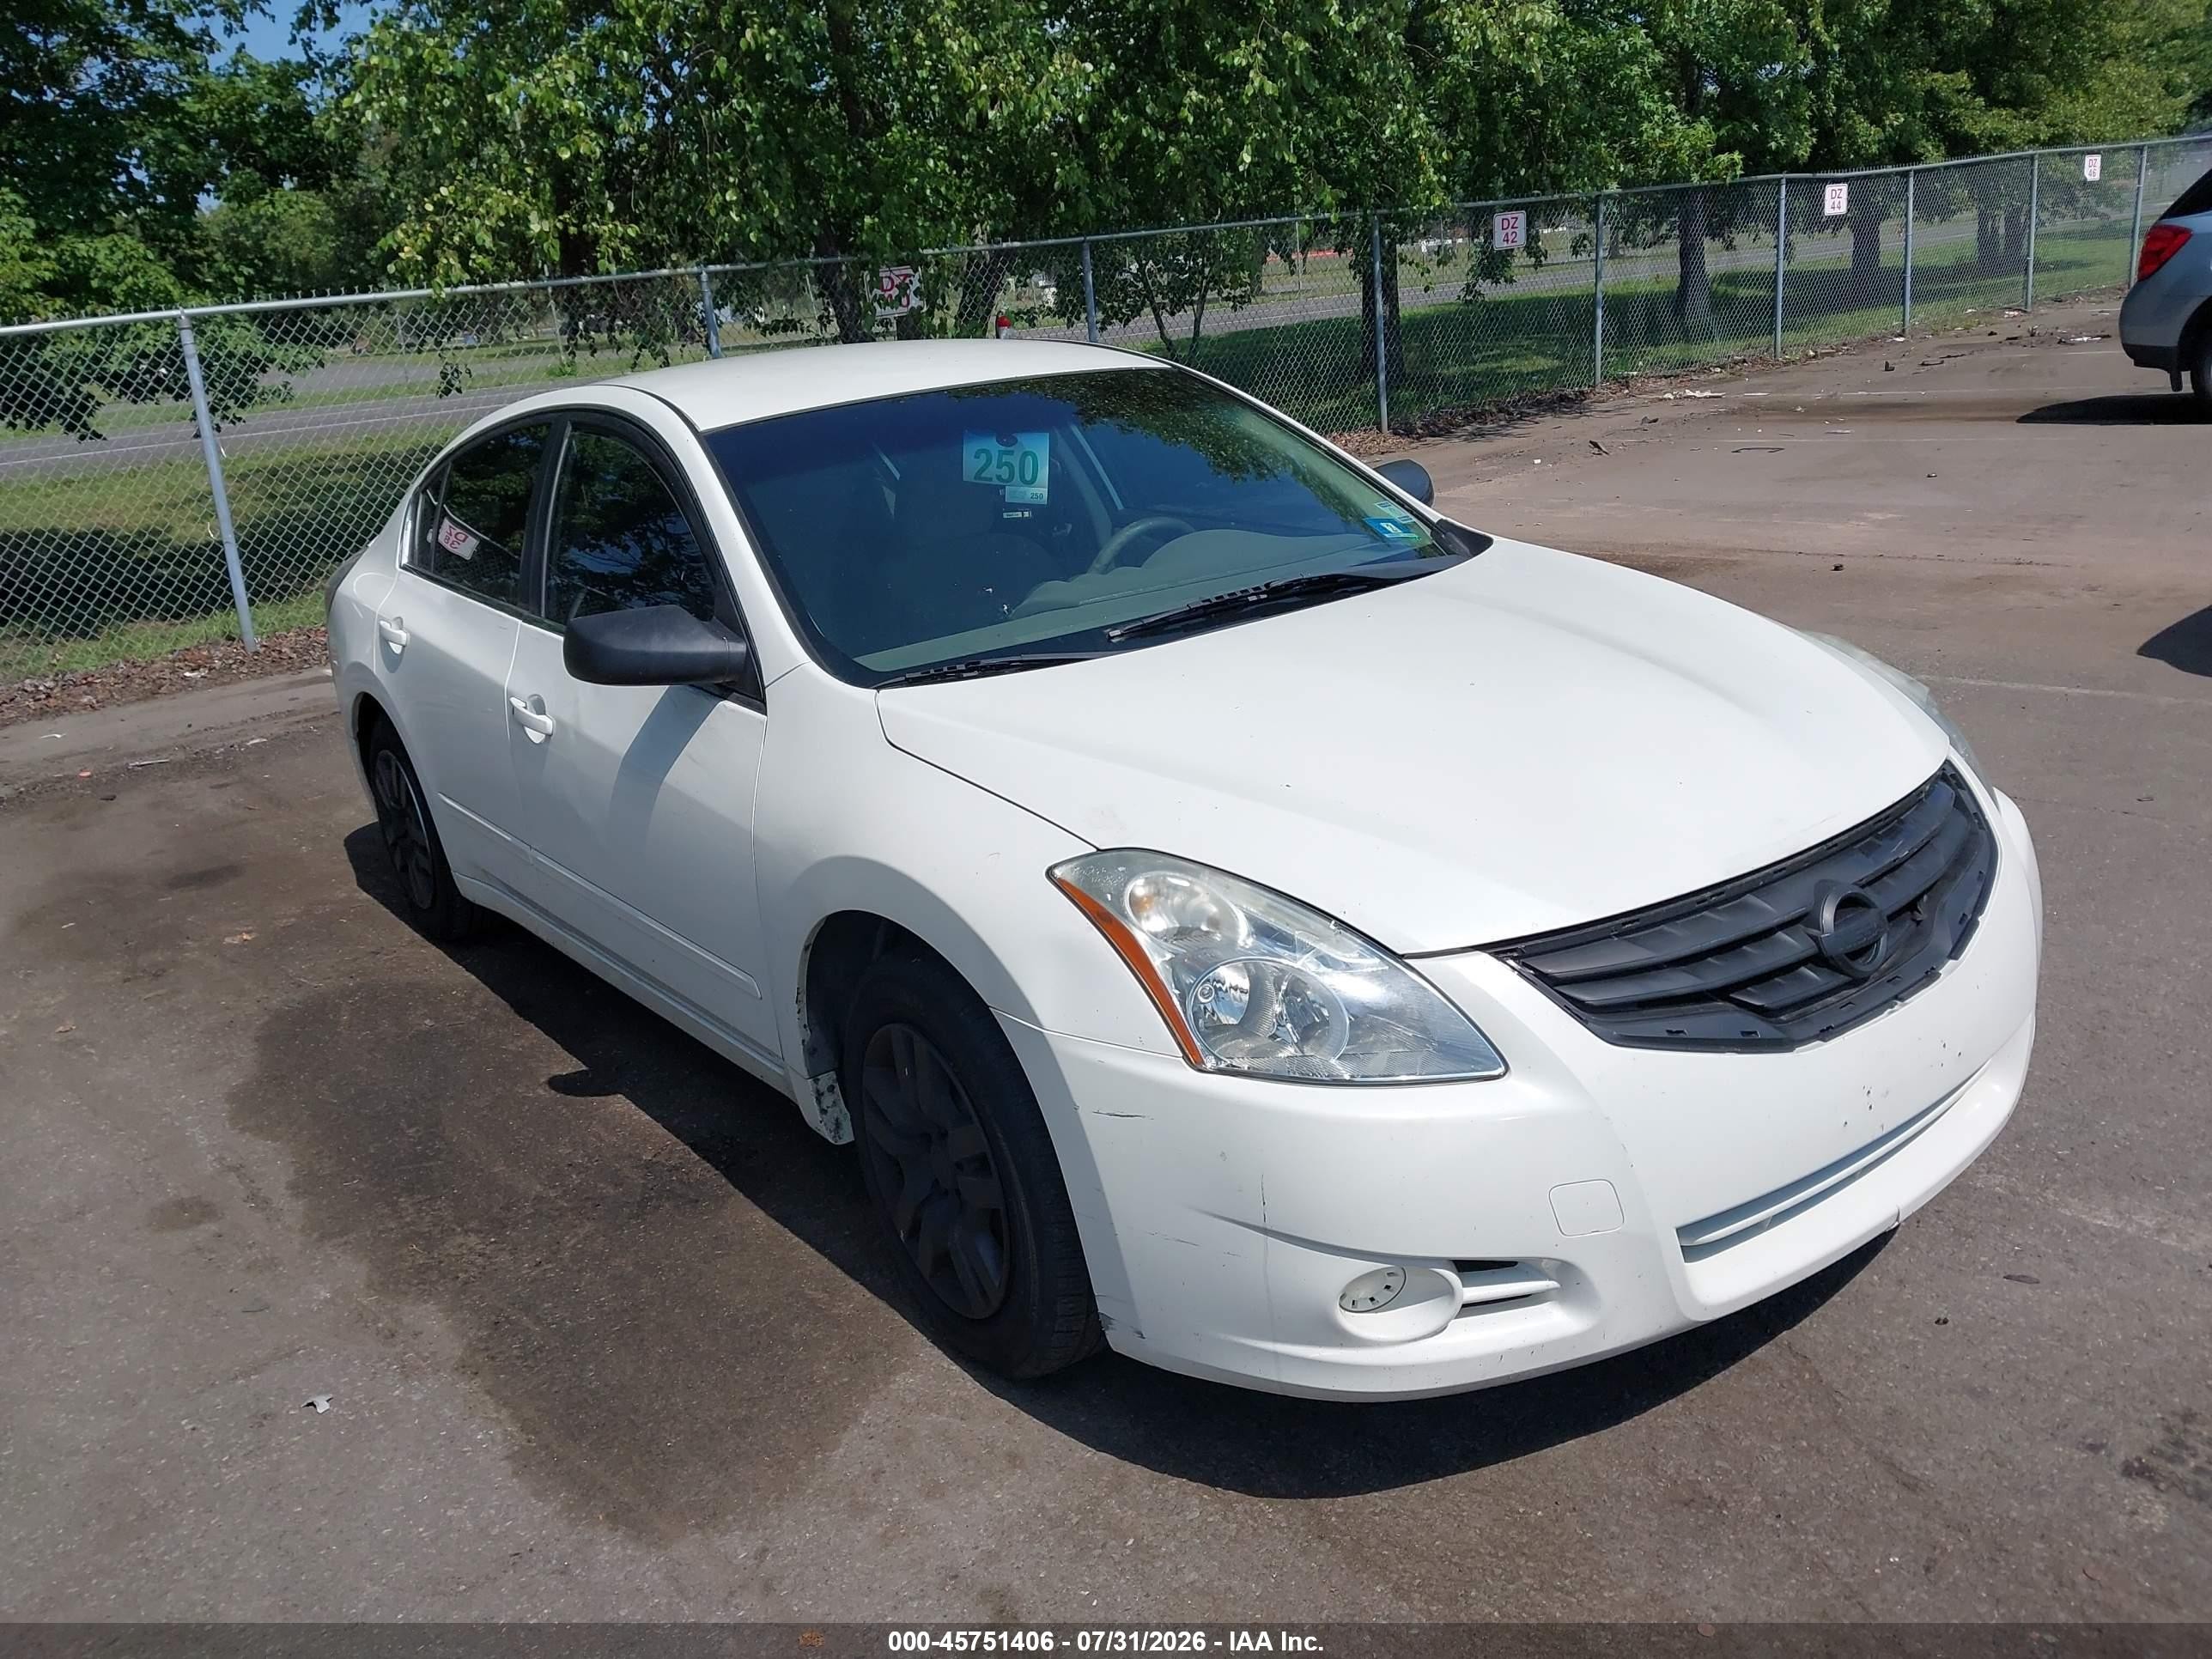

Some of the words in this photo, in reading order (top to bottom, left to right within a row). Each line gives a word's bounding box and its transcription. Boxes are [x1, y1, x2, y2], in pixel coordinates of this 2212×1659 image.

[1831, 188, 1843, 199] DZ
[1830, 200, 1842, 211] 44
[1501, 216, 1519, 231] DZ
[1503, 231, 1518, 244] 42
[973, 447, 1039, 486] 250
[1030, 492, 1044, 501] 250
